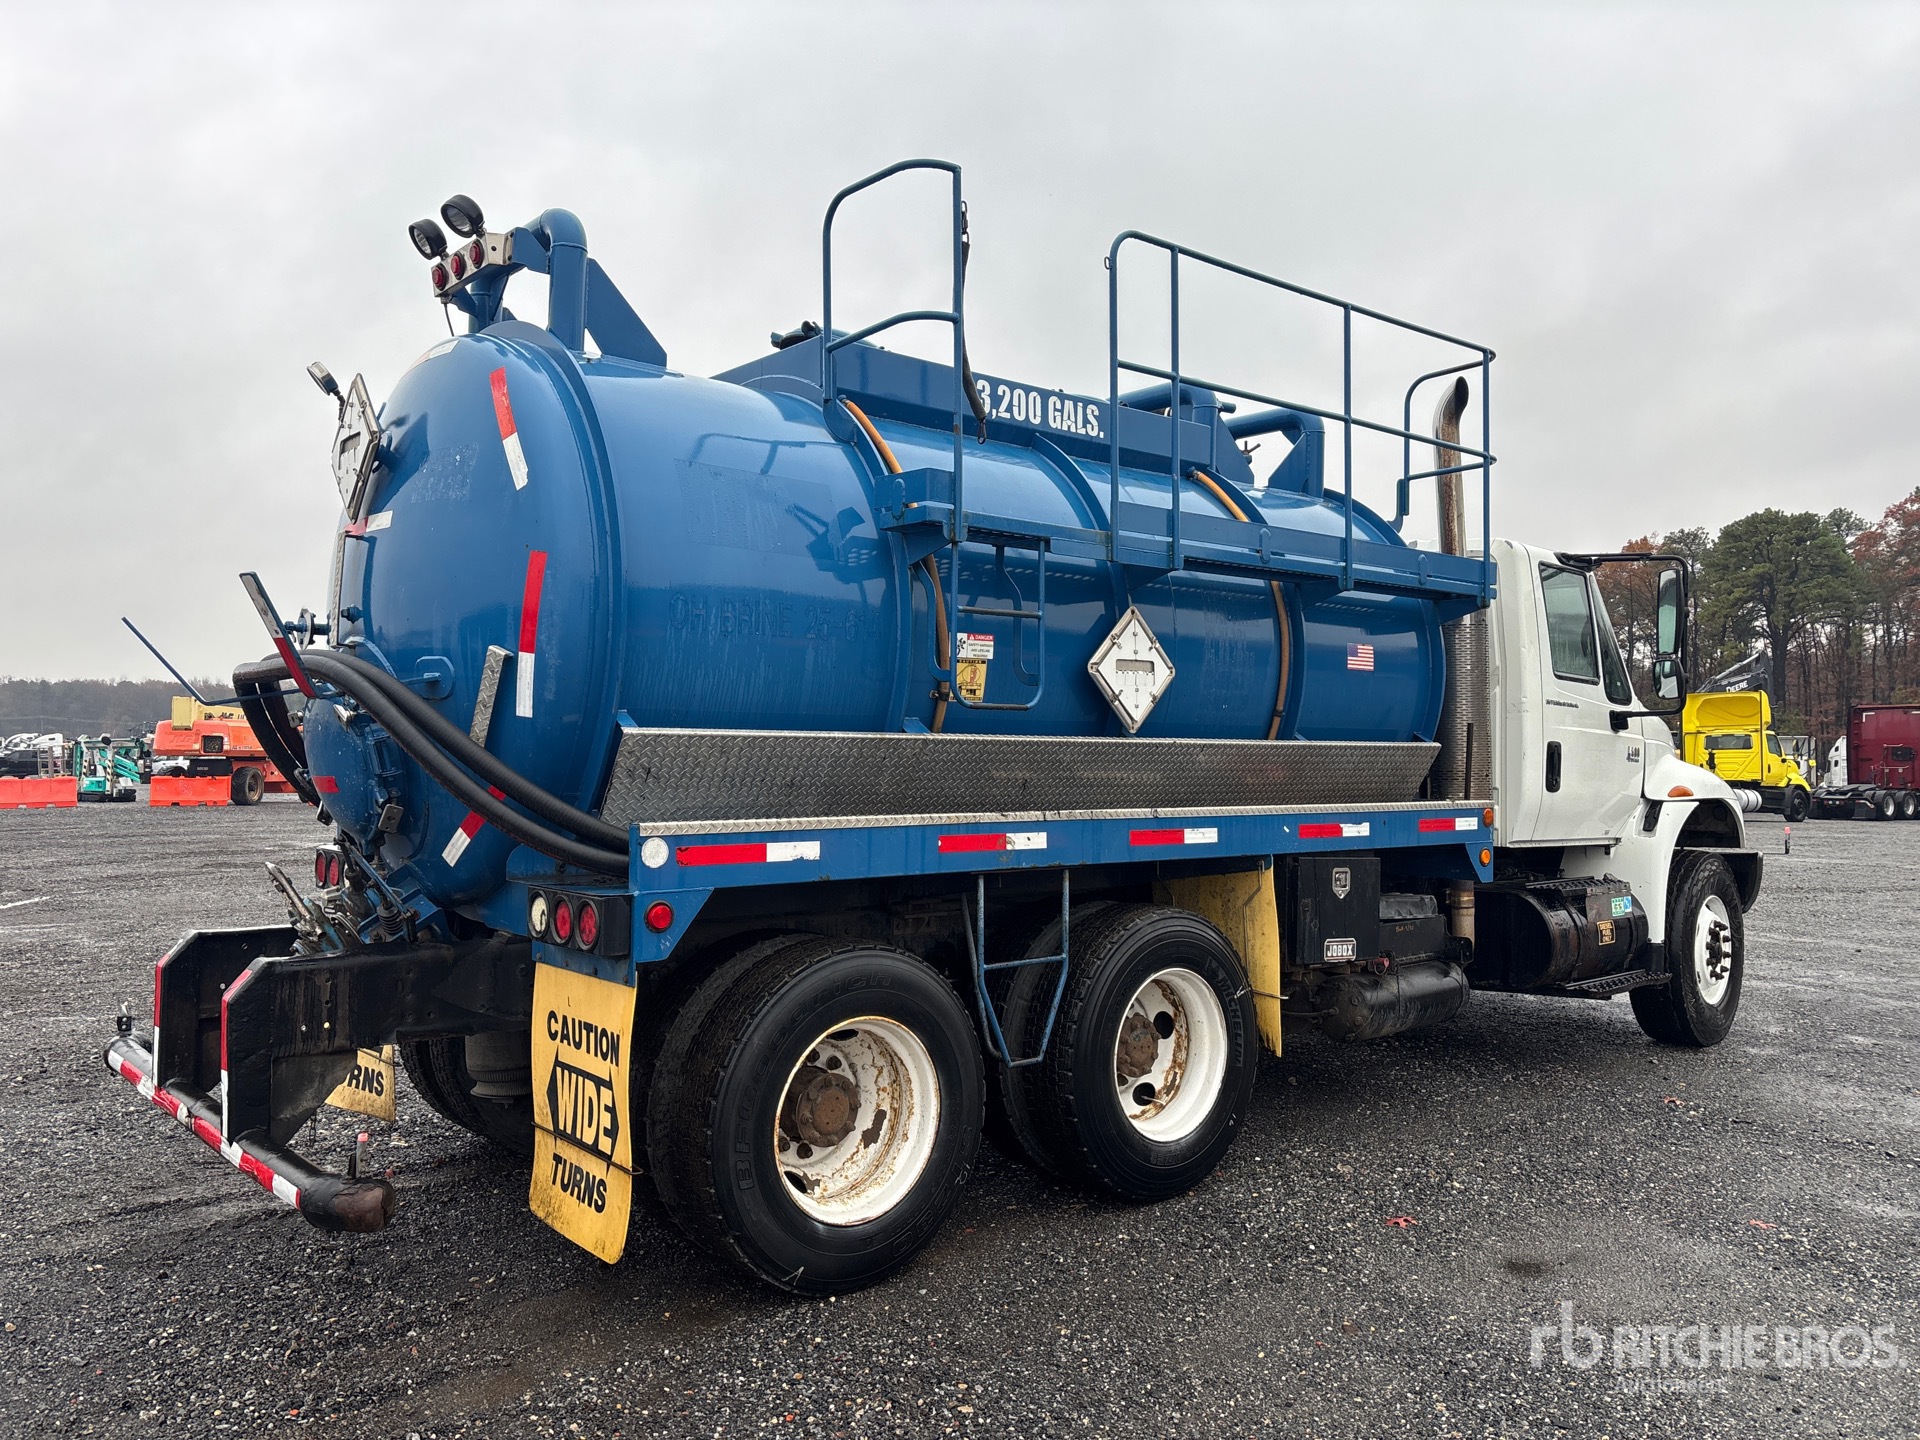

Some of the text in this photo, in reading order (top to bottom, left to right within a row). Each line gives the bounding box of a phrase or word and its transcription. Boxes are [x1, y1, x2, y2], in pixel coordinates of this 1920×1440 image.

[976, 379, 1105, 438] 3,200 GALS.
[1726, 680, 1748, 693] DEERE
[1327, 944, 1353, 957] JOBOX
[547, 1010, 620, 1068] CAUTION
[1218, 976, 1242, 1064] MICHELIN
[555, 1066, 613, 1156] WIDE
[552, 1153, 607, 1214] TURNS
